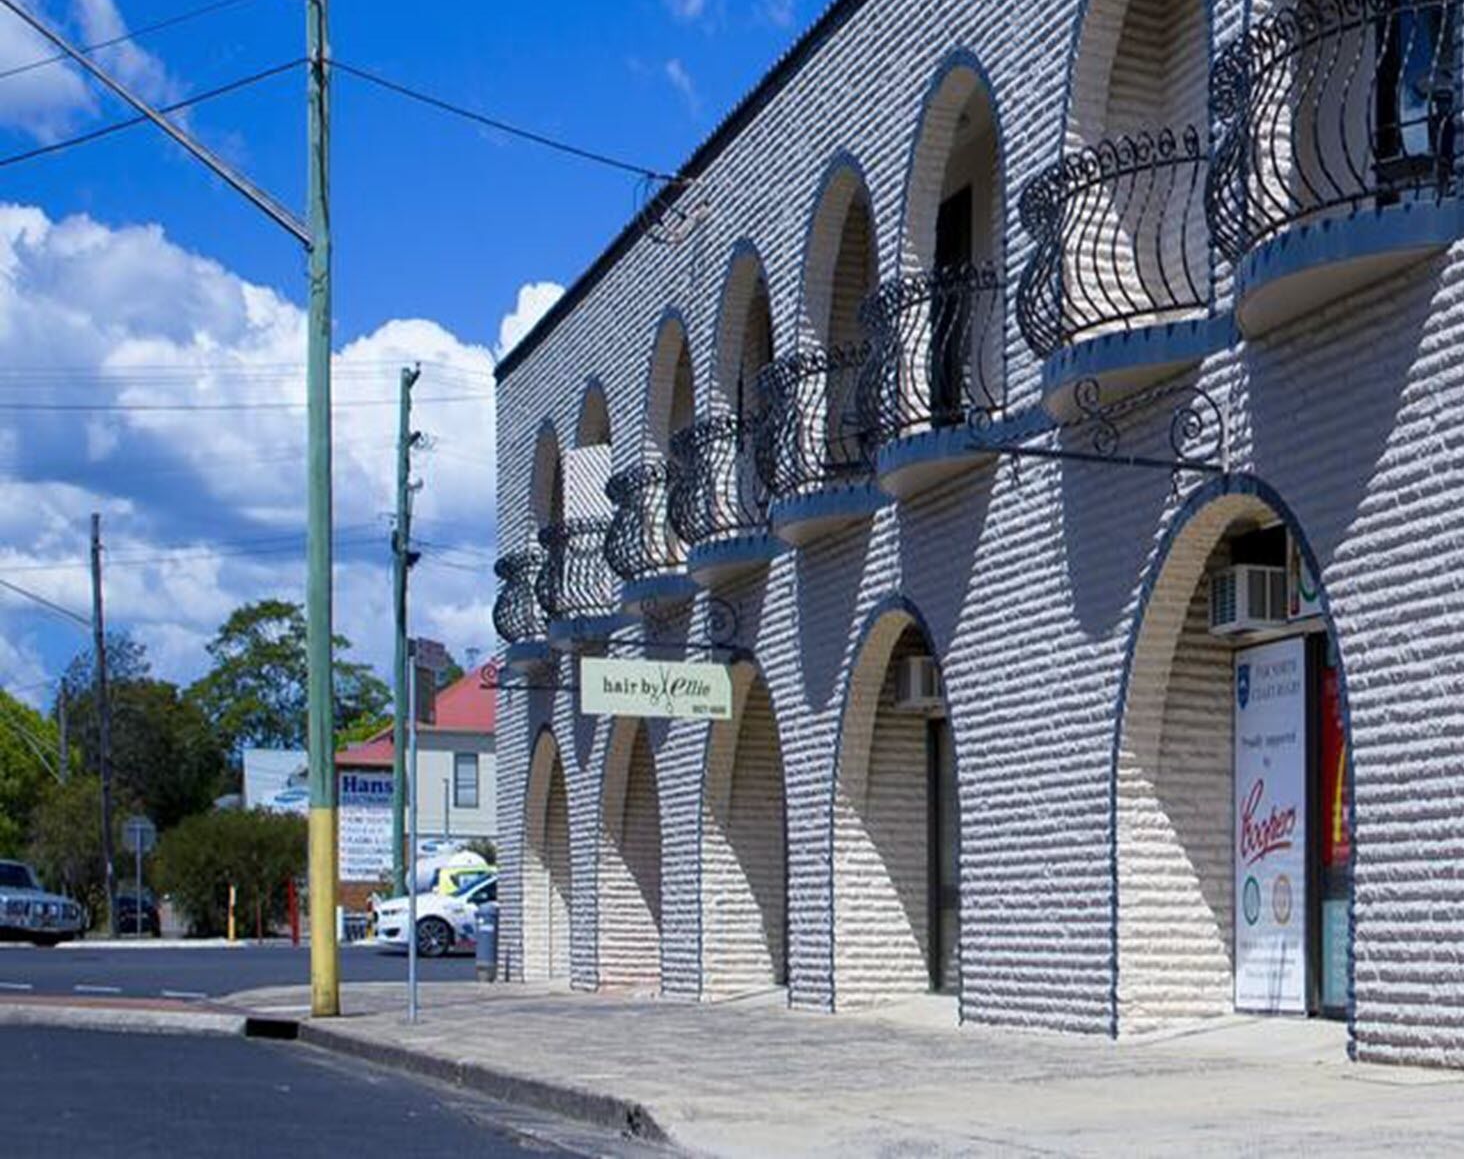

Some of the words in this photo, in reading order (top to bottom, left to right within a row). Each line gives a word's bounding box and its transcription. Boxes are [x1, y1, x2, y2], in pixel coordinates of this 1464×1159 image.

[603, 676, 639, 694] hair
[641, 676, 659, 698] by
[343, 774, 394, 793] Hans
